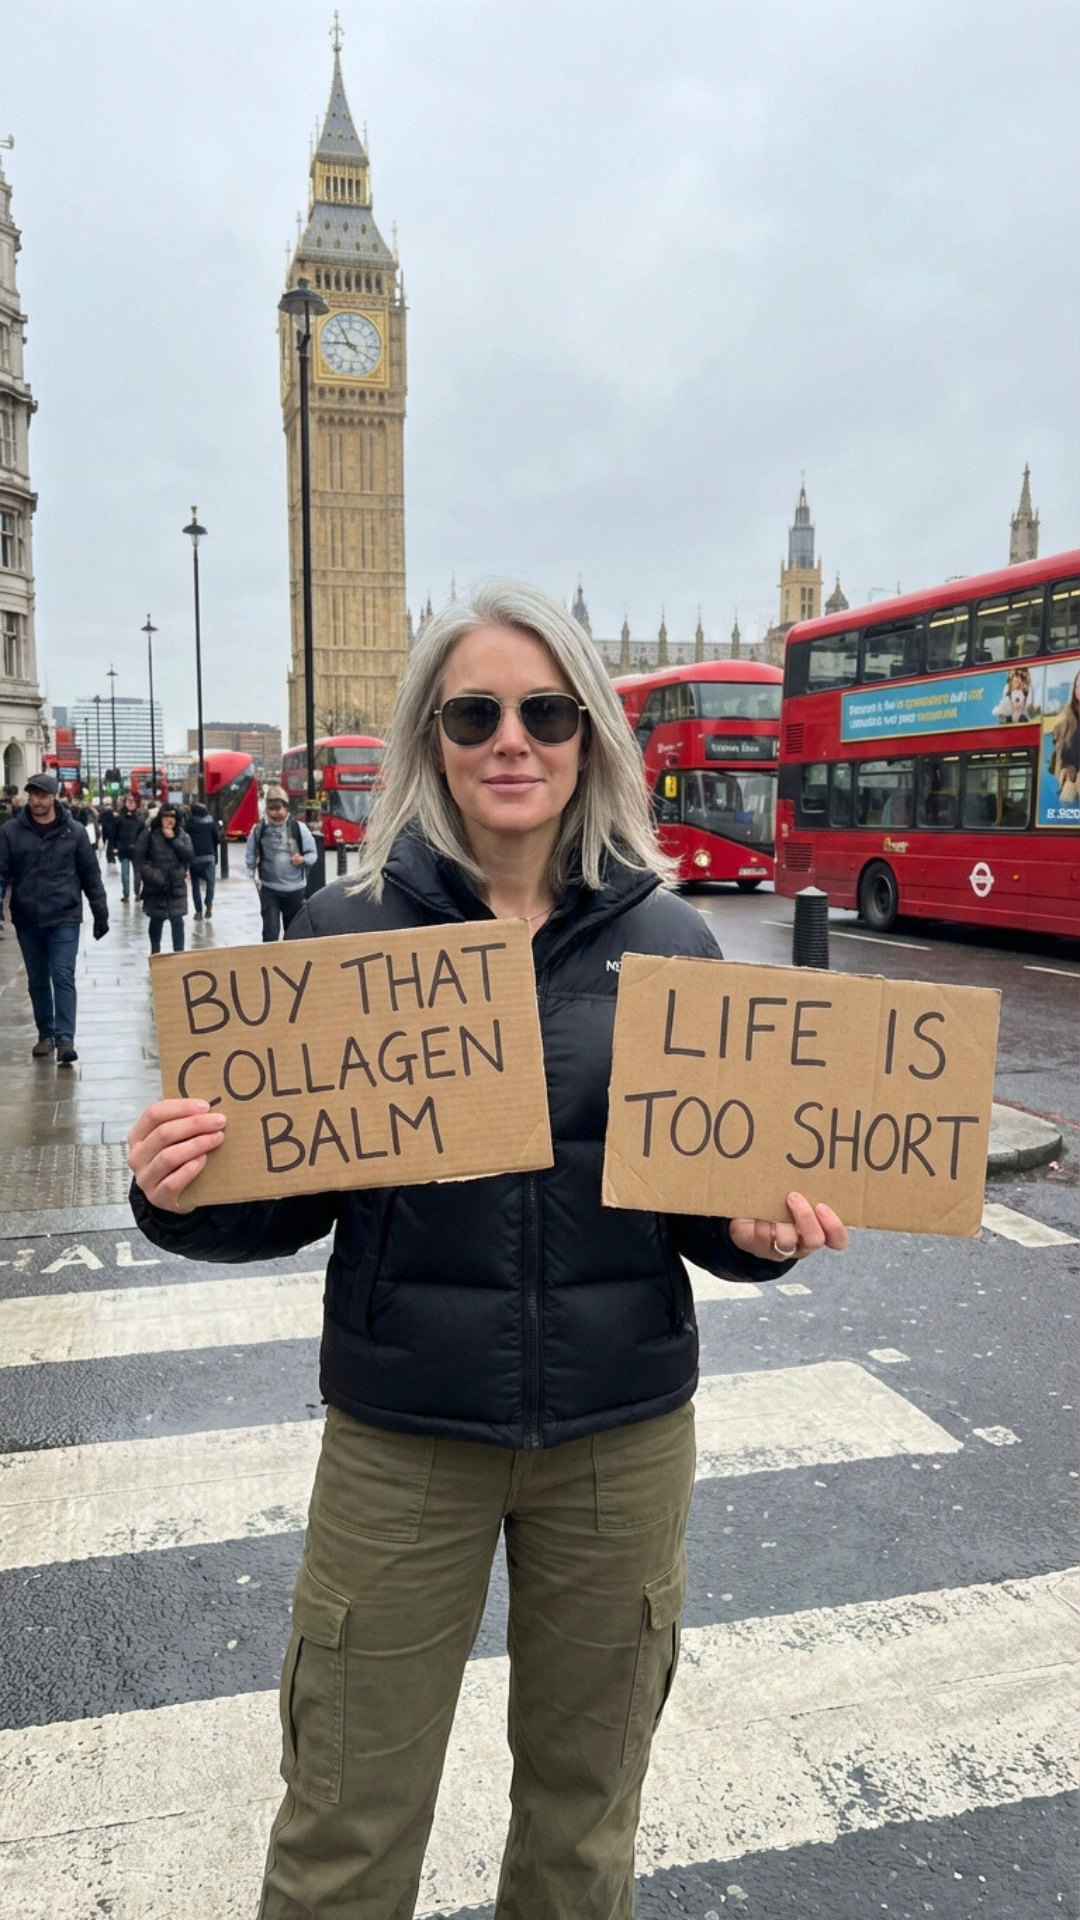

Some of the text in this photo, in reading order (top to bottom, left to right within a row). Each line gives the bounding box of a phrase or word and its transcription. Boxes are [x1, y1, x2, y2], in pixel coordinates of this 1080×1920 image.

[181, 942, 507, 1035] BUY THAT
[663, 988, 946, 1080] LIFE IS
[177, 1018, 504, 1108] COLLAGEN
[260, 1095, 444, 1174] BALM
[624, 1089, 980, 1181] TOO SHORT
